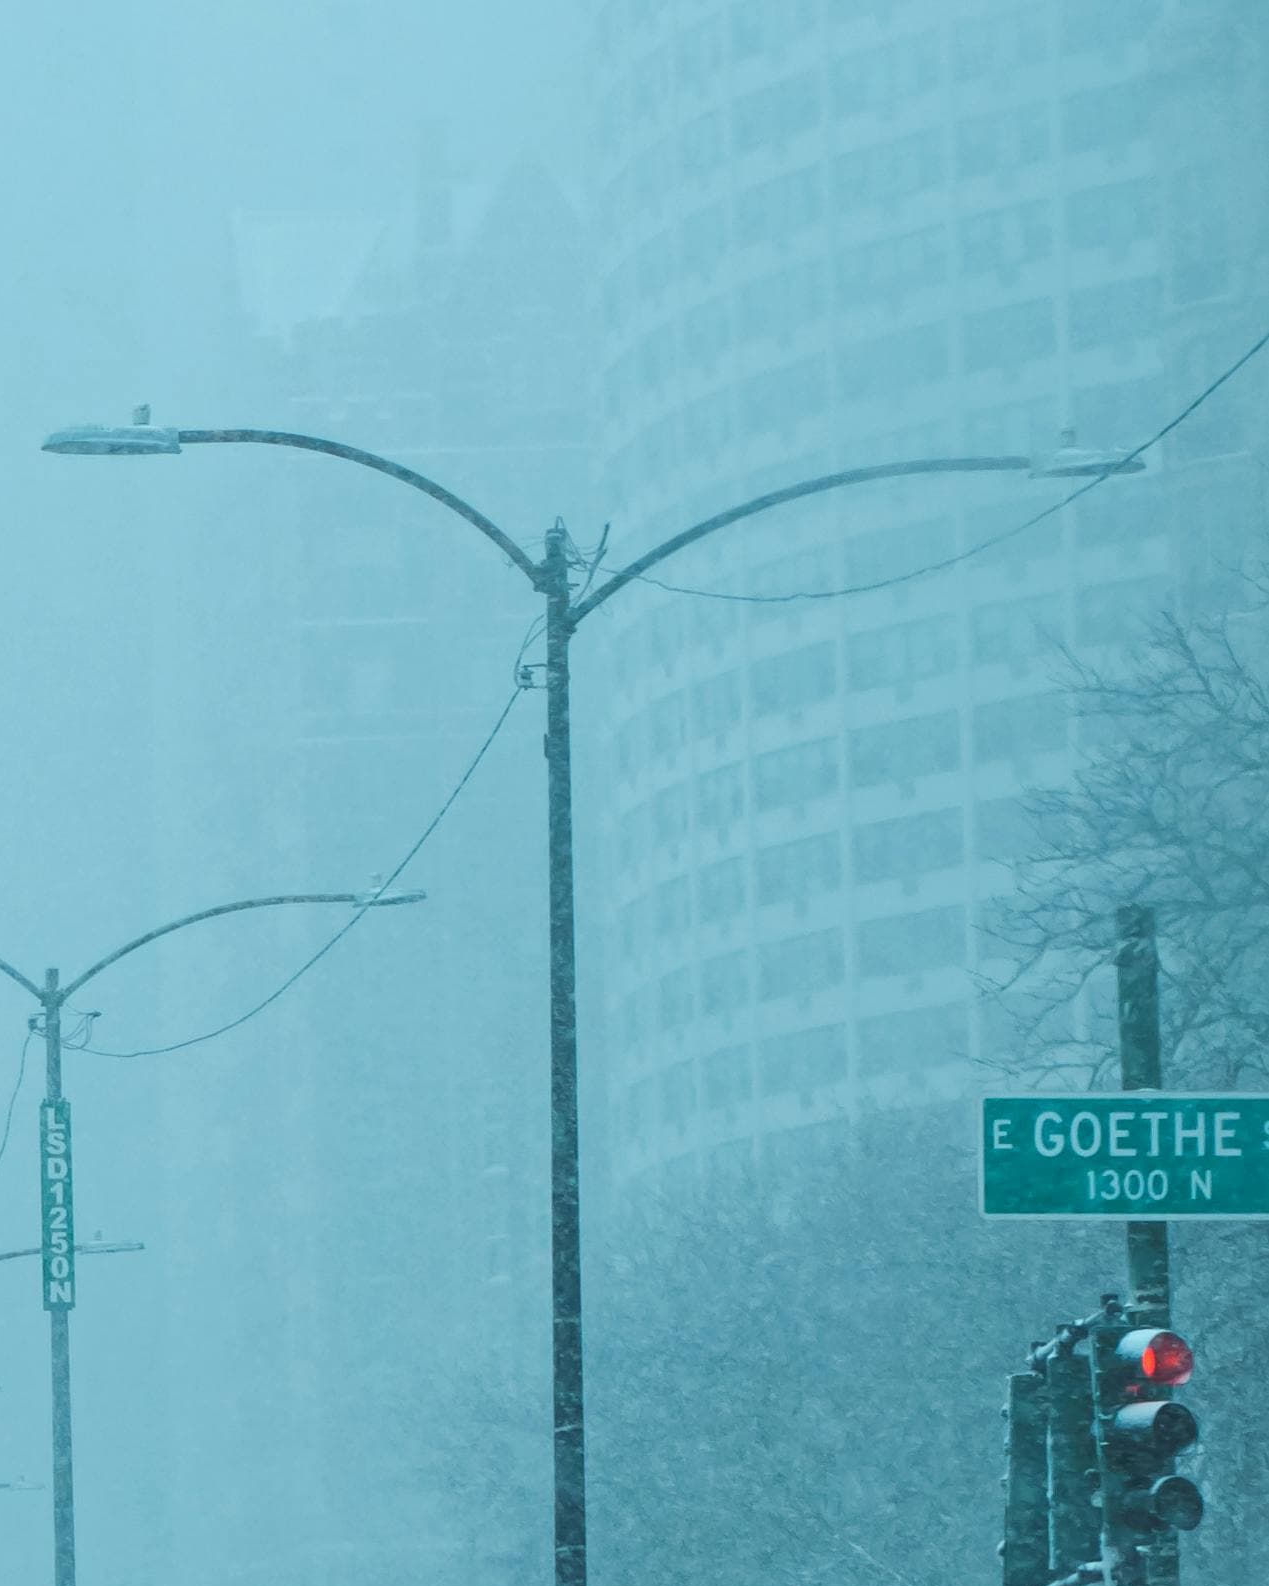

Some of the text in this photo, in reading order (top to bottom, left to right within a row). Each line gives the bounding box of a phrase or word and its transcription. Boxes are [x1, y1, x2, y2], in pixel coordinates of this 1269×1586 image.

[992, 1119, 1014, 1150] E
[1034, 1111, 1242, 1158] GOETHE
[1086, 1169, 1213, 1201] 1300 N
